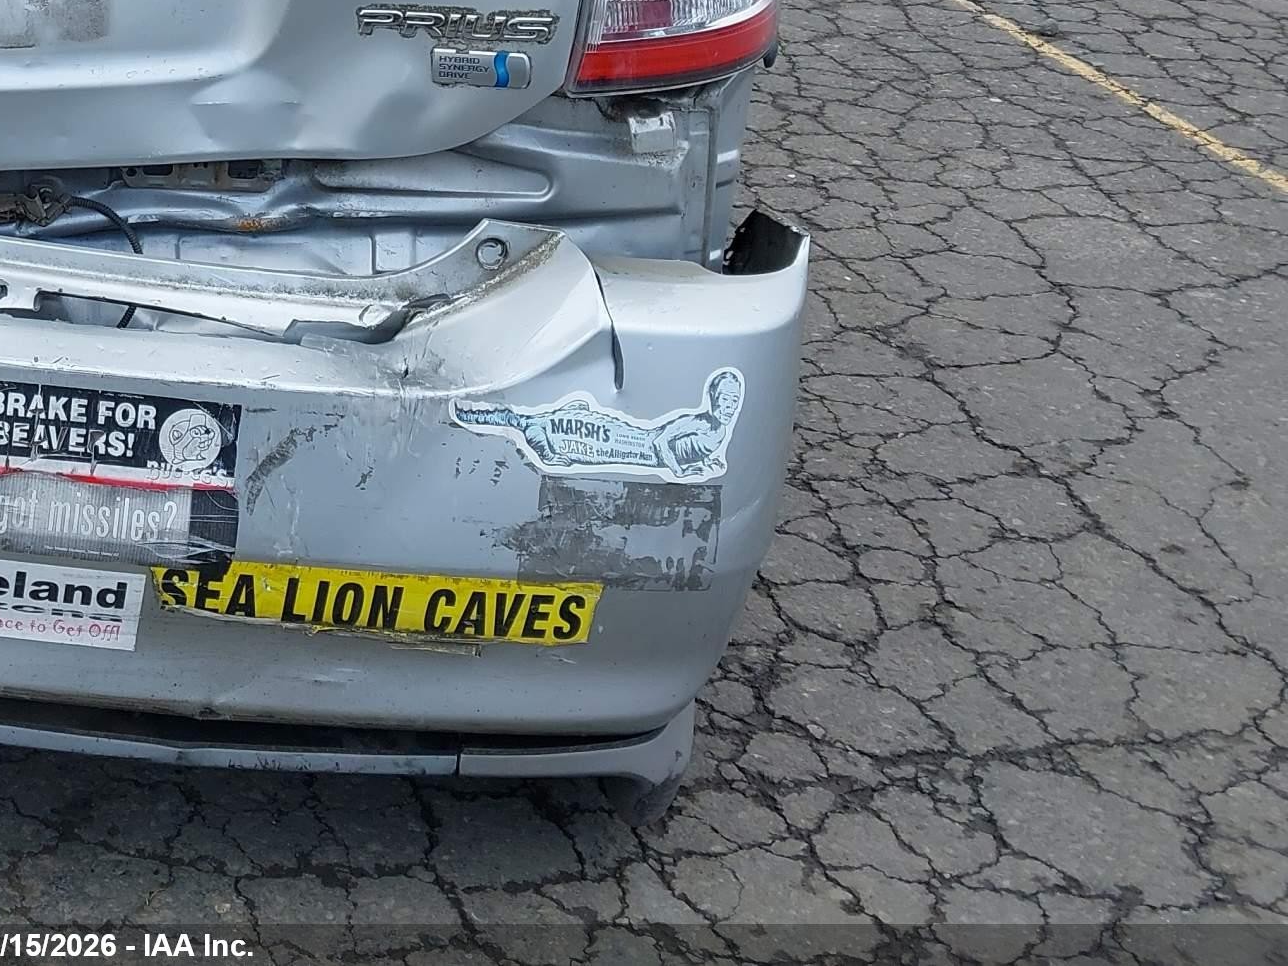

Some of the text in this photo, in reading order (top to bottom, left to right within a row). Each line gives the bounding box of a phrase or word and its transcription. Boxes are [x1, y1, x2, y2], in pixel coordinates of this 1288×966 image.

[358, 8, 555, 42] PRIUS
[439, 55, 480, 65] HYBRID
[439, 63, 490, 73] SYNERGY
[439, 71, 472, 80] DRIVE
[97, 400, 158, 430] FOR
[559, 439, 593, 457] JAKE
[47, 492, 179, 541] missiles?
[161, 568, 586, 640] SEA LION CAVES
[29, 619, 46, 633] to
[52, 619, 83, 636] Get
